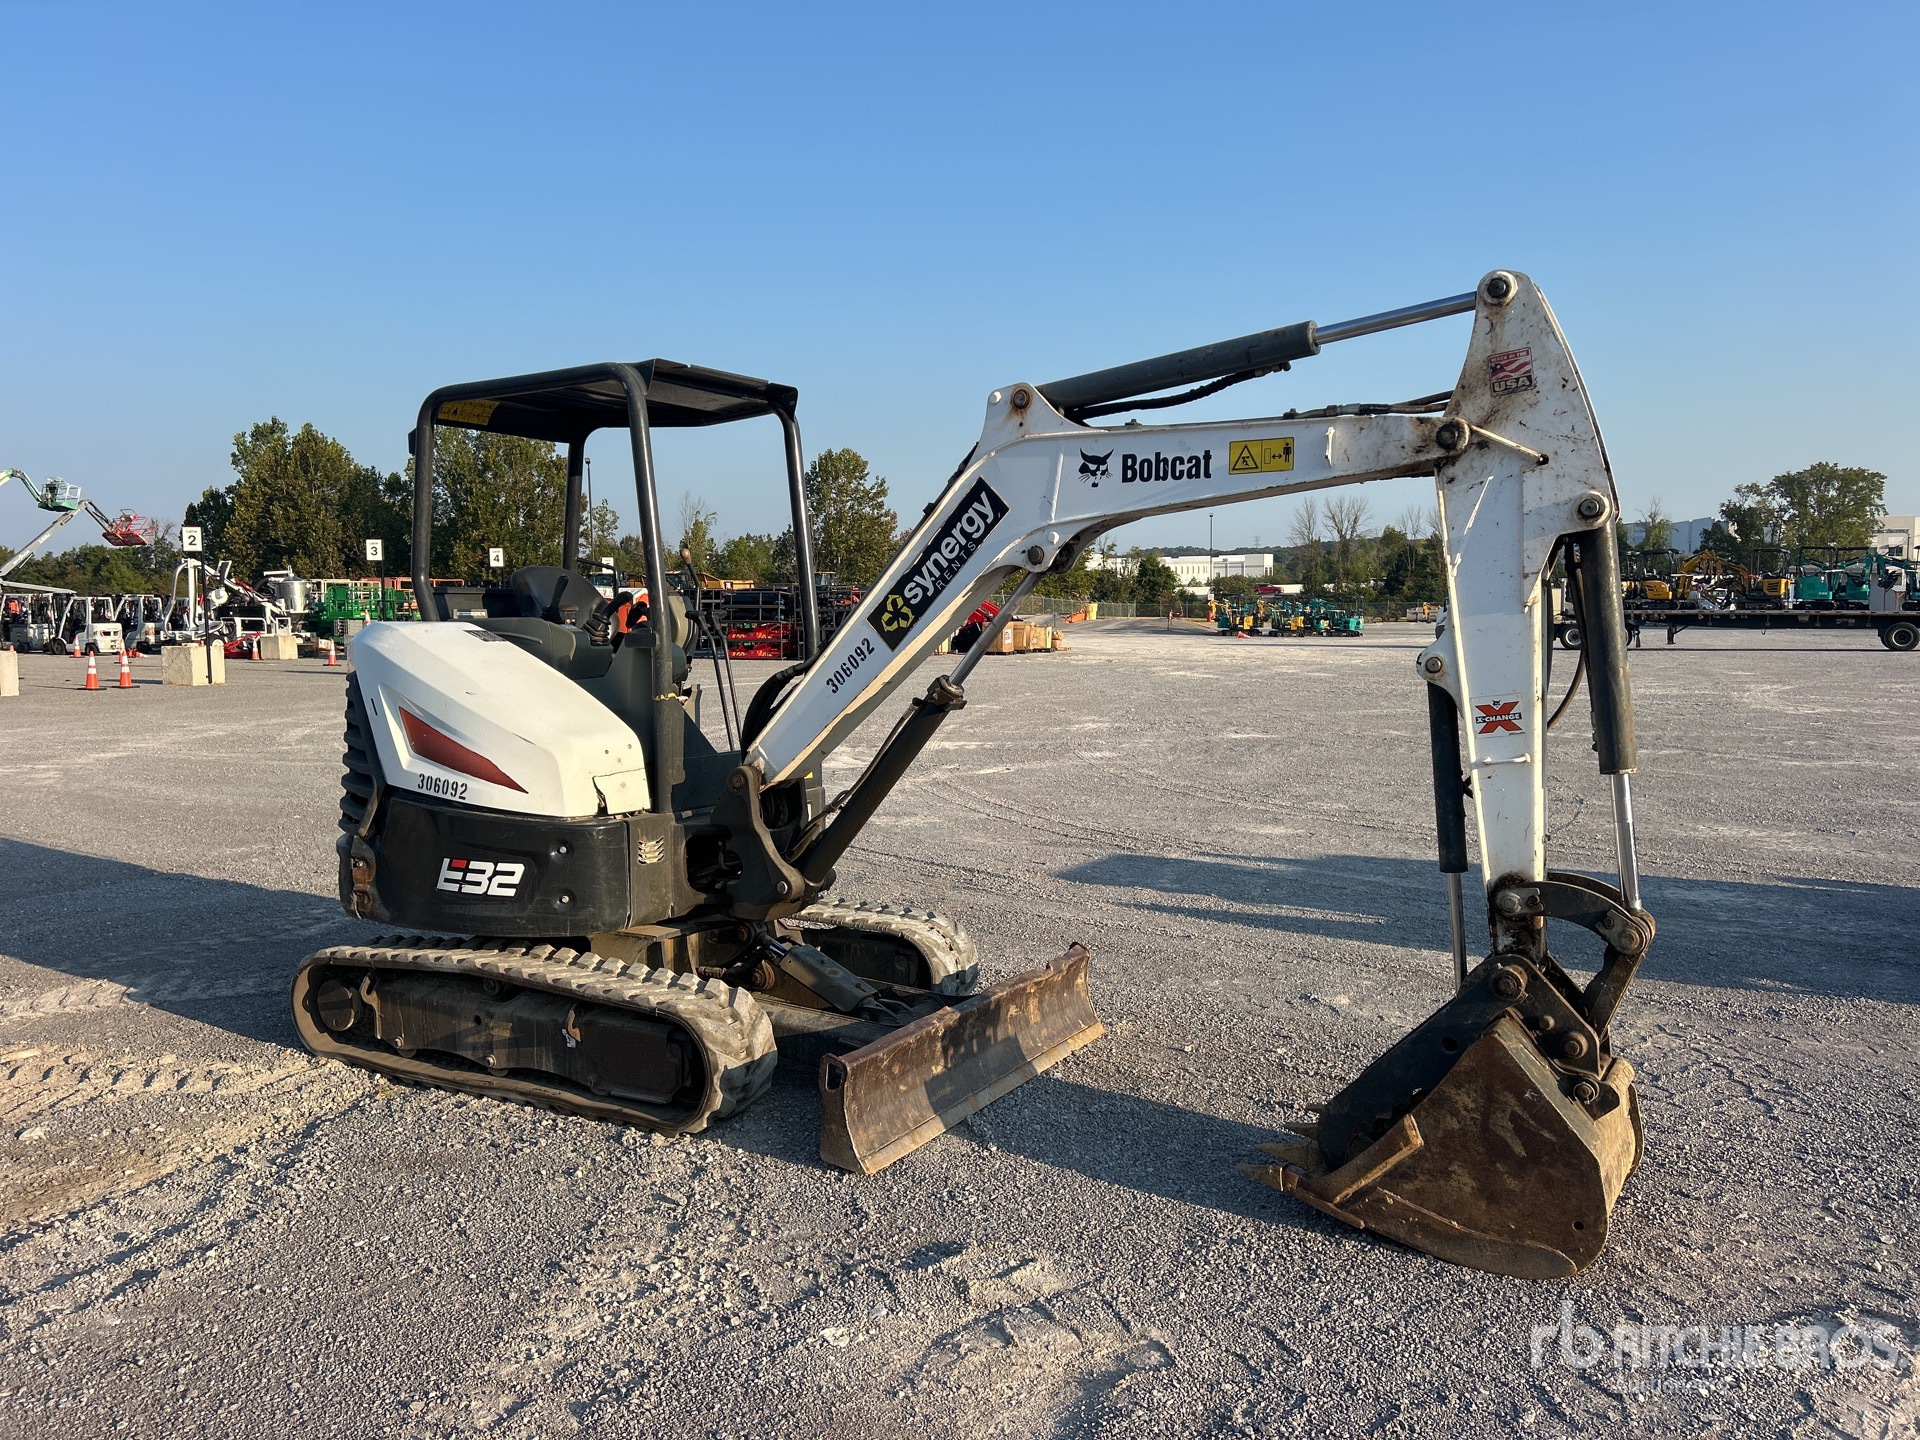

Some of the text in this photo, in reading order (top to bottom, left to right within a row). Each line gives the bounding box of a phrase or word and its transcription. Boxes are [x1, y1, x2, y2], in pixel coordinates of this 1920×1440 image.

[1494, 377, 1529, 392] USA
[1122, 450, 1212, 483] Bobcat
[188, 534, 197, 546] 2
[370, 546, 378, 556] 3
[904, 491, 995, 605] synergy
[493, 554, 500, 563] 4
[935, 541, 977, 591] RENTS
[826, 637, 875, 694] 306092
[1477, 713, 1521, 723] X-CHANGE
[417, 773, 468, 800] 306092
[436, 857, 526, 897] E32
